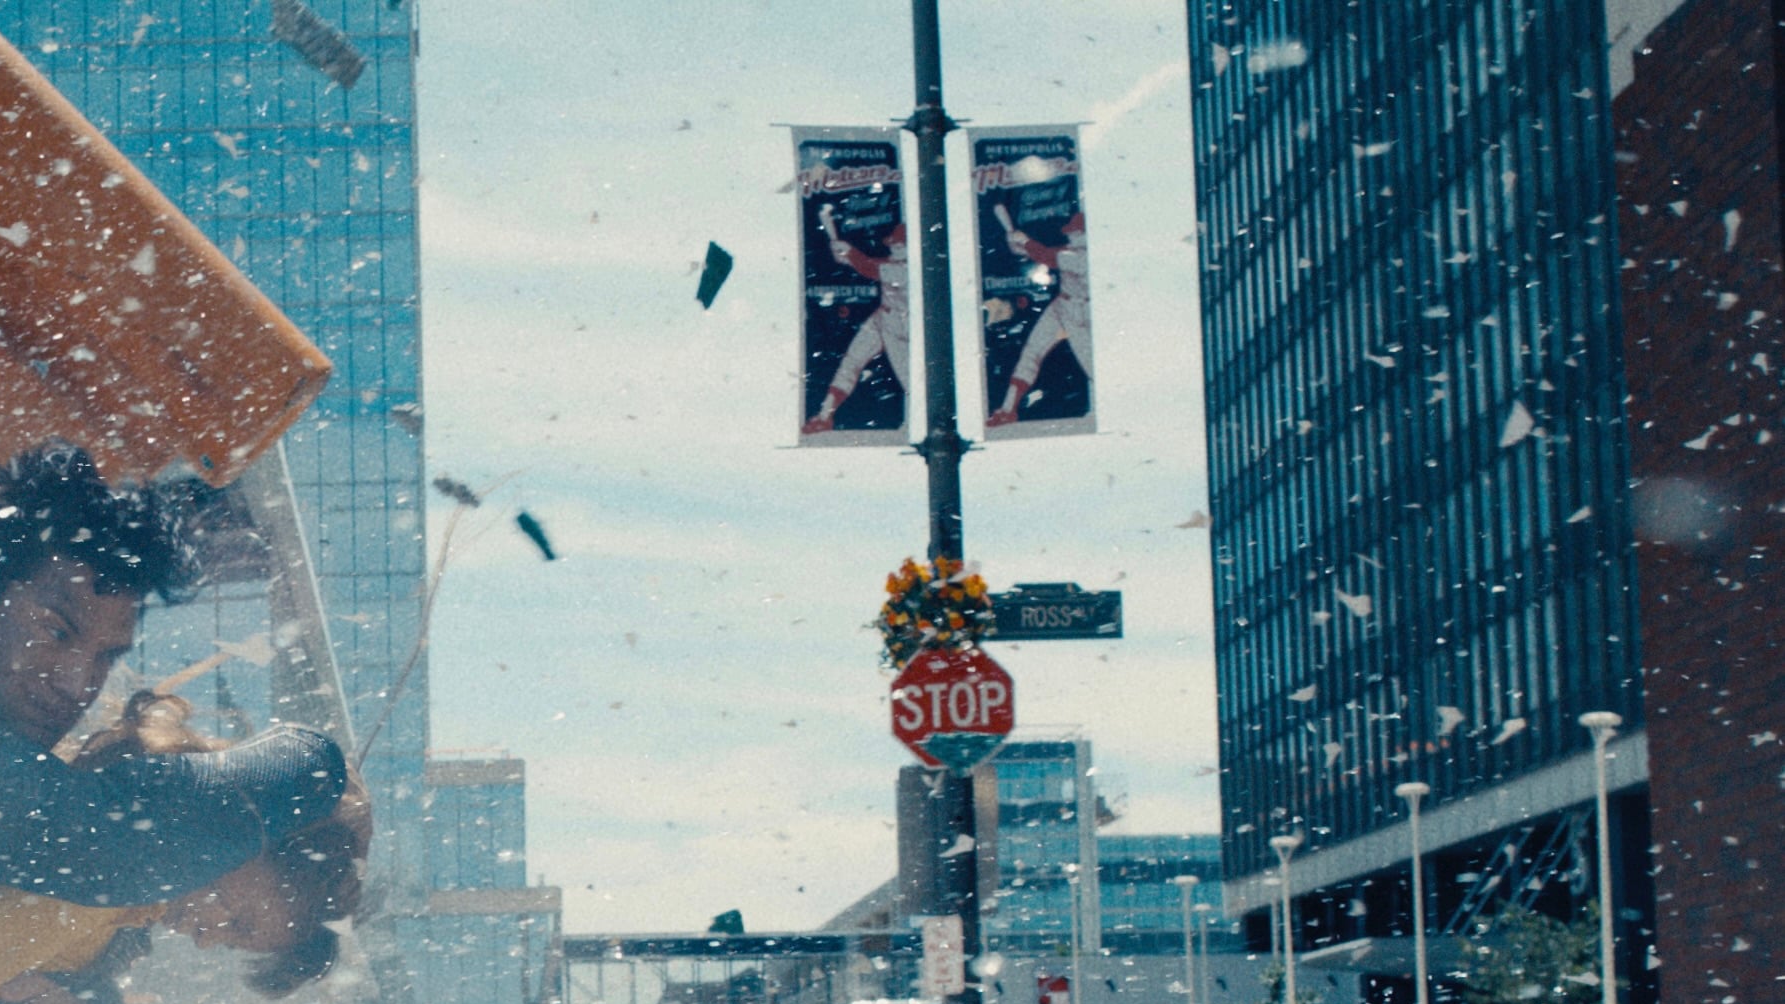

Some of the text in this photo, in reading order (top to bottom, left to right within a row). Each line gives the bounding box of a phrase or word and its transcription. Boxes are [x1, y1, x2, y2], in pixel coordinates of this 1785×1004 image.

[985, 142, 1064, 155] METROPOLIS
[1021, 605, 1073, 627] ROSS
[898, 681, 1007, 730] STOP
